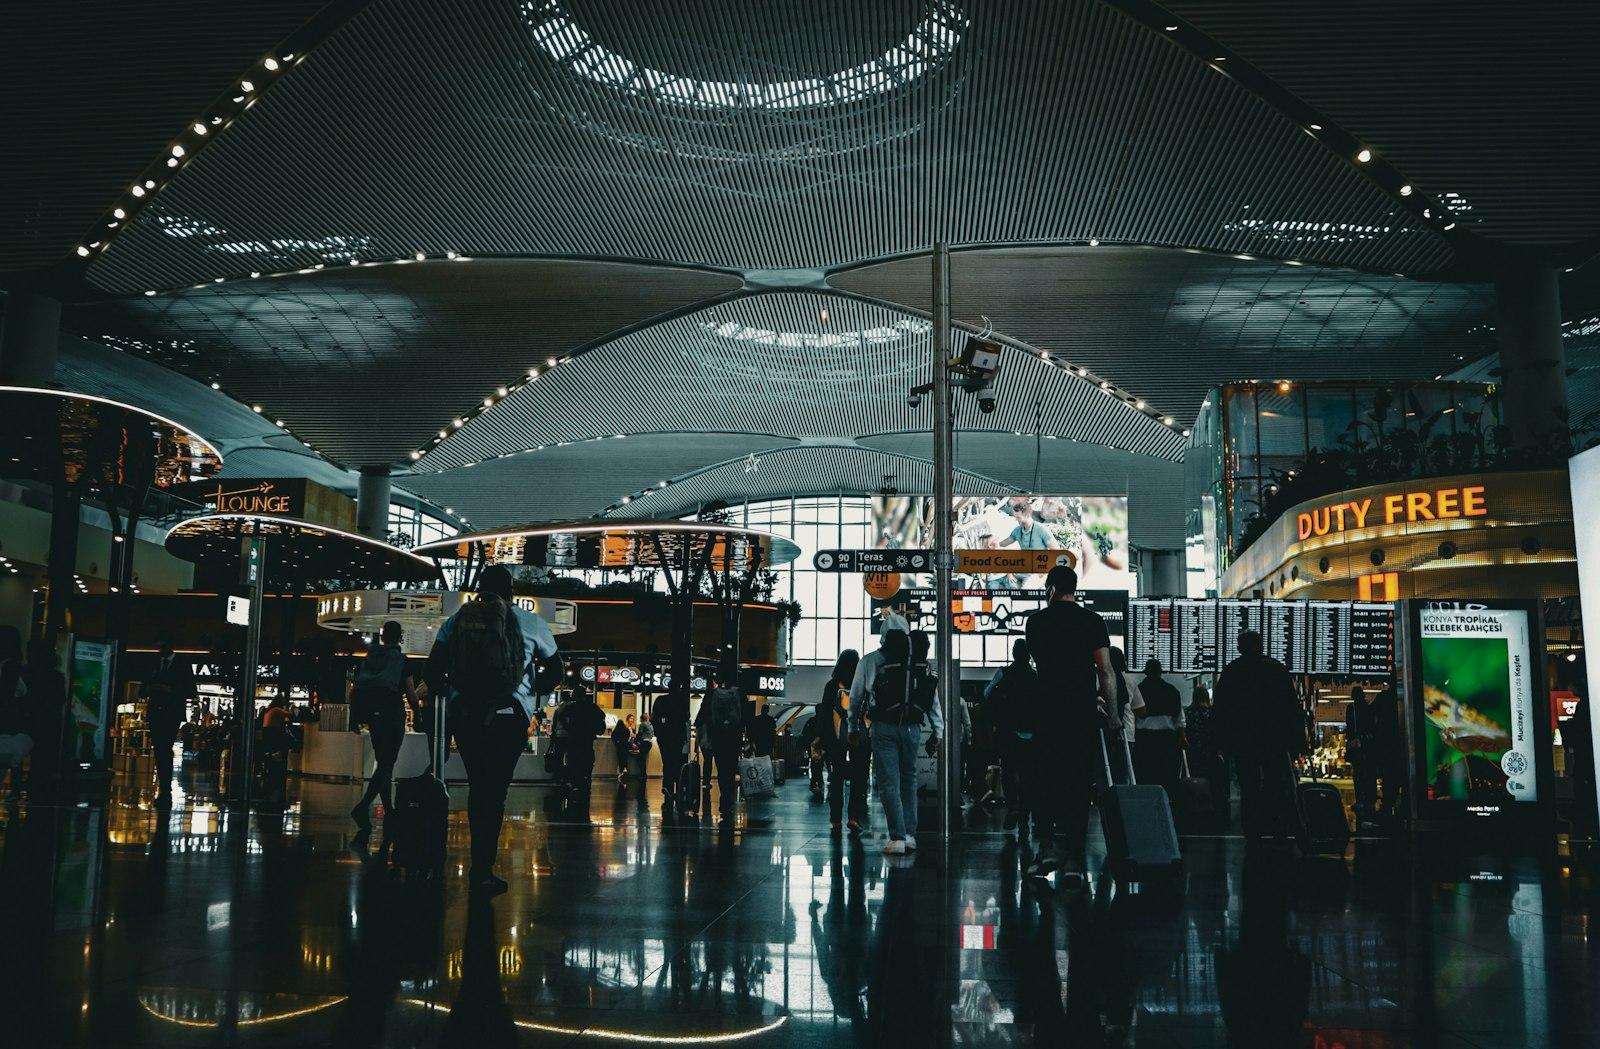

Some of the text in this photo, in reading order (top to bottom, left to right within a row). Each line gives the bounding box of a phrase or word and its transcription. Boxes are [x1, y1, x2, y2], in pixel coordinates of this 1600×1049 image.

[1297, 485, 1489, 541] DUTY FREE
[838, 553, 850, 562] 90
[858, 552, 884, 561] Teras
[1036, 554, 1049, 562] 40
[963, 556, 1025, 567] Food Court
[858, 562, 893, 571] Terrace
[1424, 614, 1499, 623] KONYA TROPİKAL
[1424, 623, 1503, 634] KELEBEK BAHÇESİ
[759, 676, 785, 691] BOSS
